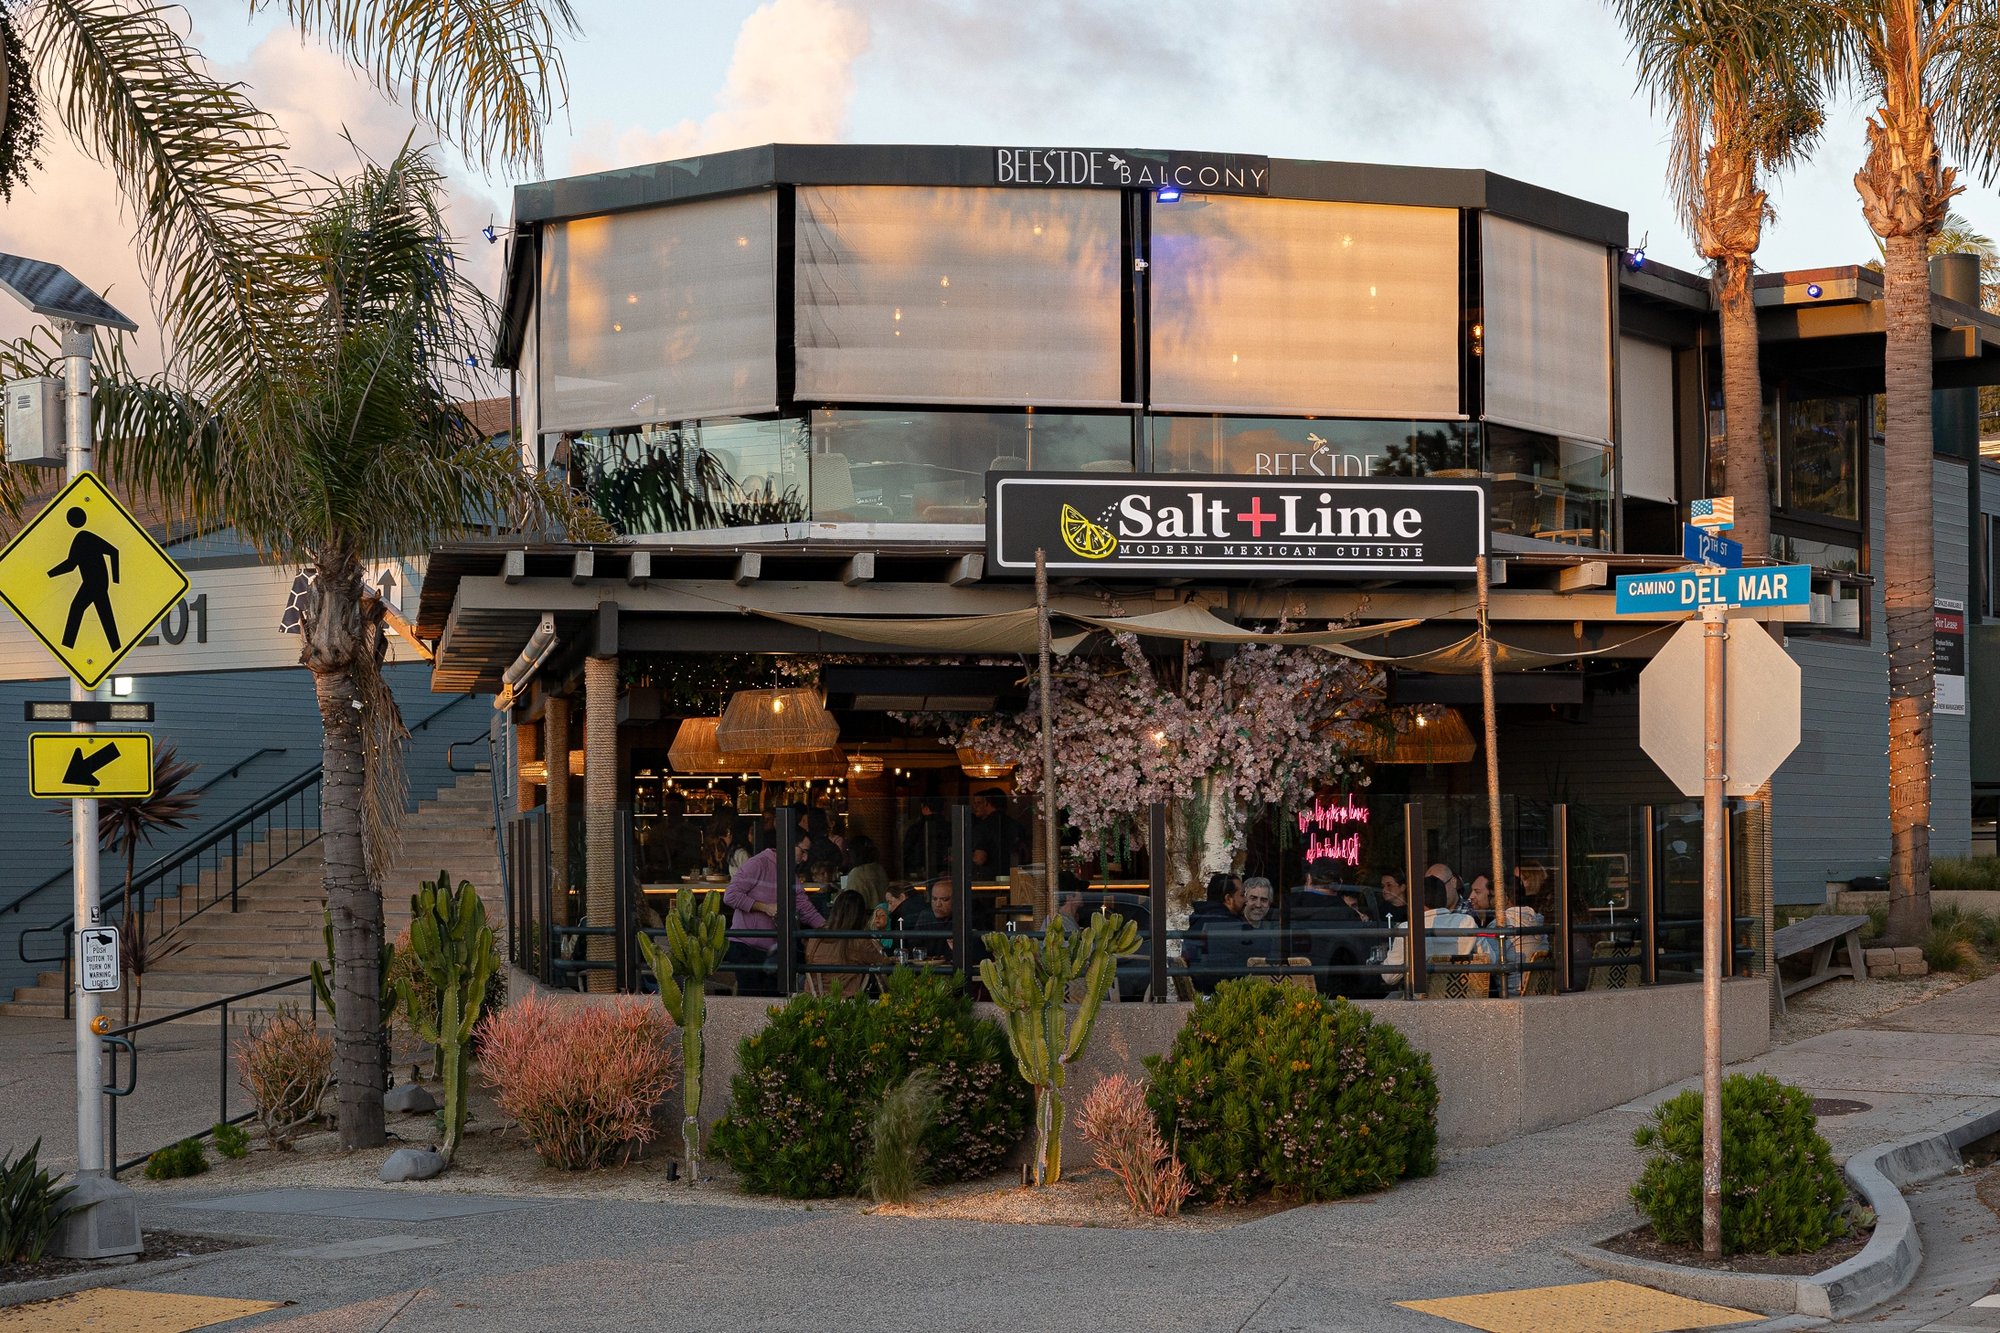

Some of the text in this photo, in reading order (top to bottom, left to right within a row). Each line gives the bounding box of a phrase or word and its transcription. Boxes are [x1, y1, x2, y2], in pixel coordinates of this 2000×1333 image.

[998, 149, 1266, 189] BEESIDE BALCONY
[1119, 544, 1423, 558] MODERN MEXICAN CUISINE
[1720, 541, 1728, 556] ST
[1628, 573, 1789, 605] CAMINO DEL MAR
[138, 594, 207, 646] 01
[1944, 618, 1958, 630] Lease
